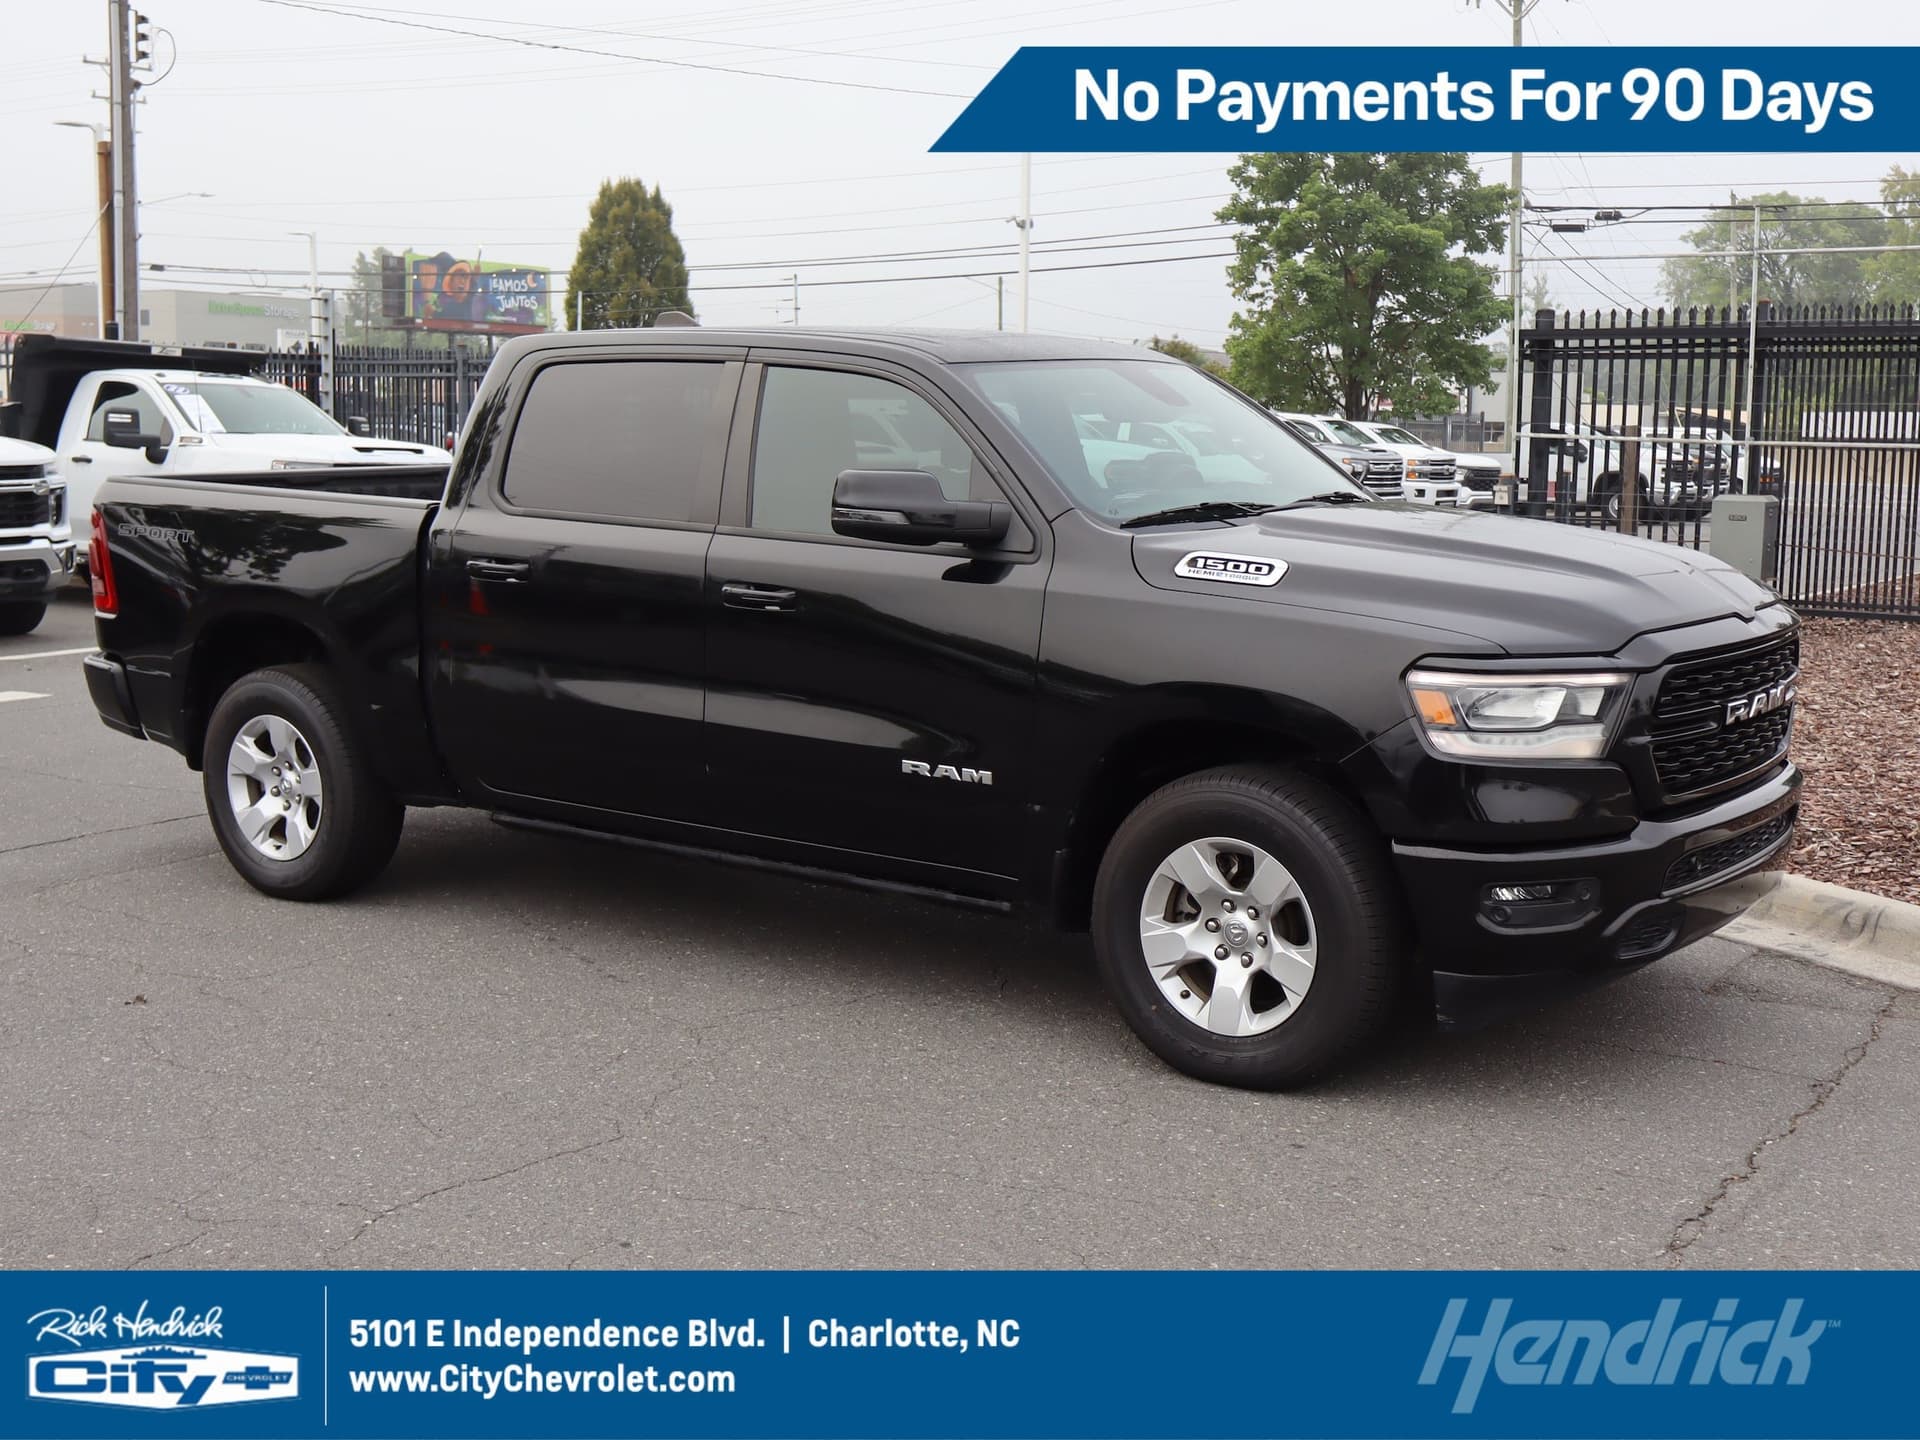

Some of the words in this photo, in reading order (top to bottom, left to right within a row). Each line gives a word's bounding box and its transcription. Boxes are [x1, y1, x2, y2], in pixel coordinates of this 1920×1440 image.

[496, 295, 538, 312] JUNTOS
[118, 523, 195, 543] SPORT
[1195, 557, 1270, 575] 1500
[1725, 685, 1786, 726] RAM
[901, 759, 993, 785] RAM
